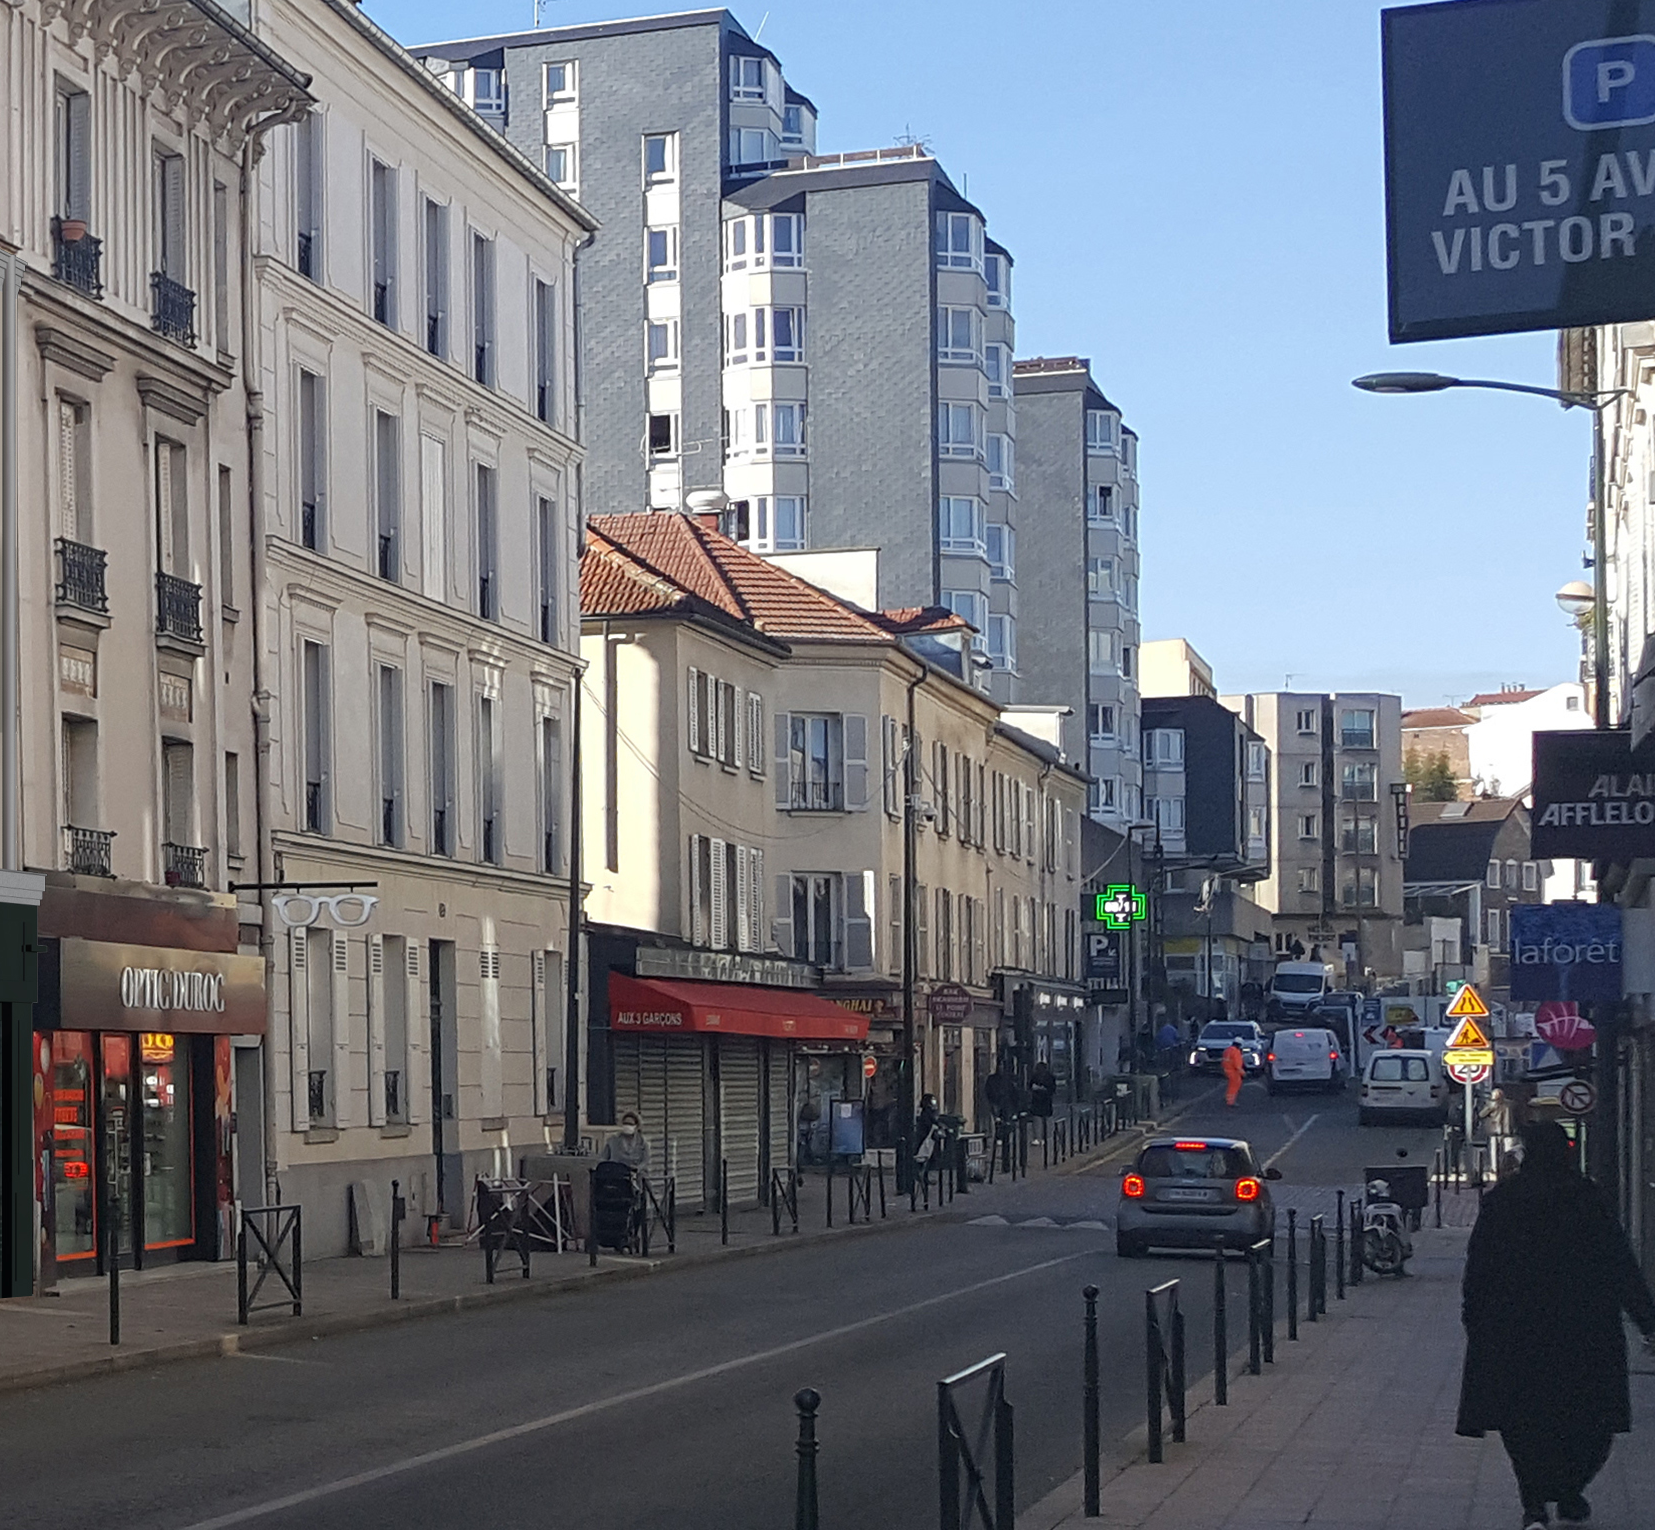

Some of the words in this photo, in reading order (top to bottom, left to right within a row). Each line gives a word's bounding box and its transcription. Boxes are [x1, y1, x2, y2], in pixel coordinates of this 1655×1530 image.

[1597, 60, 1636, 104] P
[1442, 163, 1517, 216] AU
[1540, 159, 1571, 206] 5
[1431, 212, 1636, 275] VICTOR
[1514, 936, 1621, 965] laforêt
[121, 966, 170, 1010] OPTIC
[172, 971, 225, 1013] DUROC
[617, 1013, 635, 1025] AUX
[643, 1013, 682, 1027] GARÇONS
